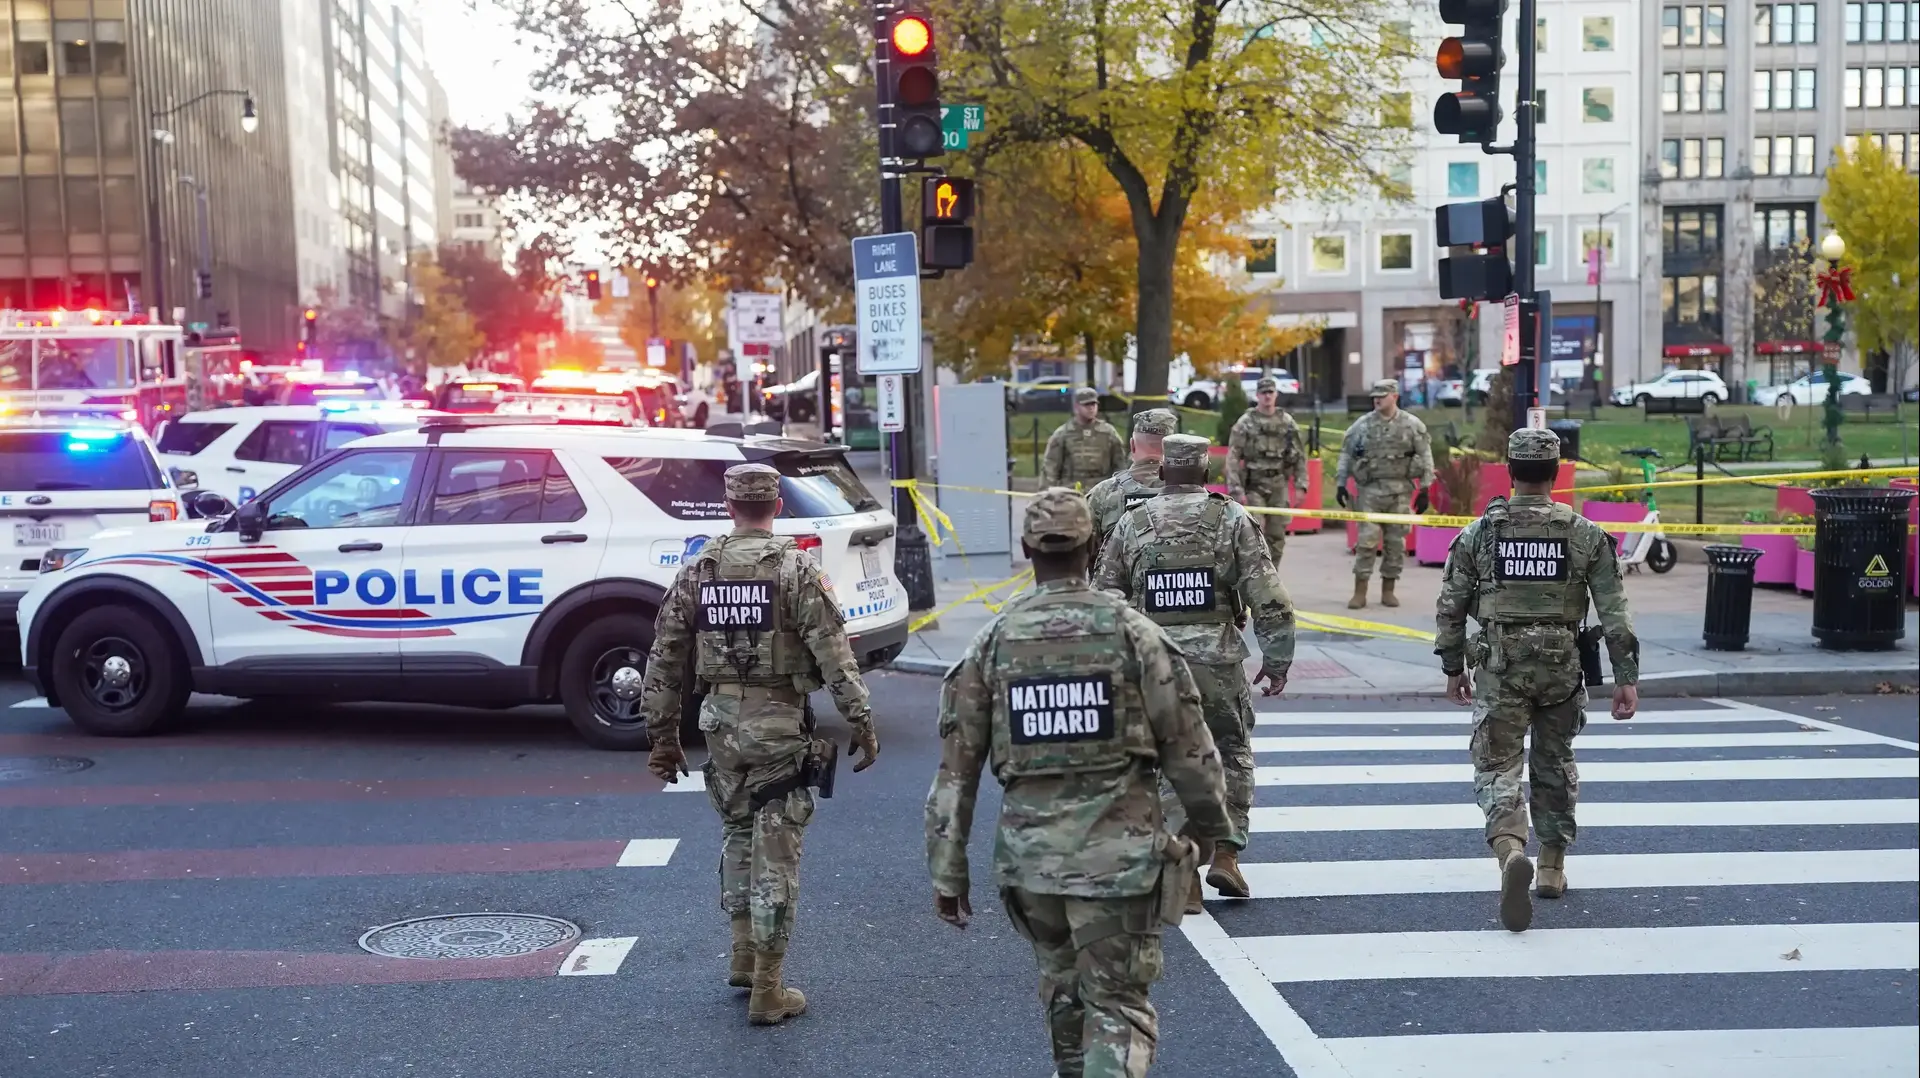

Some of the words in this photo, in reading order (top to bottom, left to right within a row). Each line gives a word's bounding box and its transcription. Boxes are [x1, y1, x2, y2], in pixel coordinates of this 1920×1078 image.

[963, 107, 980, 119] ST
[963, 118, 980, 130] NW
[872, 243, 896, 256] RIGHT
[874, 260, 897, 273] LANE
[868, 284, 906, 300] BUSES
[870, 302, 907, 318] BIKES
[871, 319, 905, 333] ONLY
[671, 500, 694, 508] Policing
[682, 509, 705, 517] Serving
[186, 535, 211, 546] 315
[1498, 541, 1564, 559] NATIONAL
[1504, 560, 1557, 576] GUARD
[315, 568, 543, 605] POLICE
[1147, 572, 1211, 590] NATIONAL
[1858, 580, 1893, 588] GOLDEN
[701, 585, 770, 605] NATIONAL
[868, 589, 885, 600] POLICE
[1155, 590, 1205, 607] GUARD
[707, 606, 762, 624] GUARD
[1011, 681, 1109, 711] NATIONAL
[1023, 708, 1100, 737] GUARD
